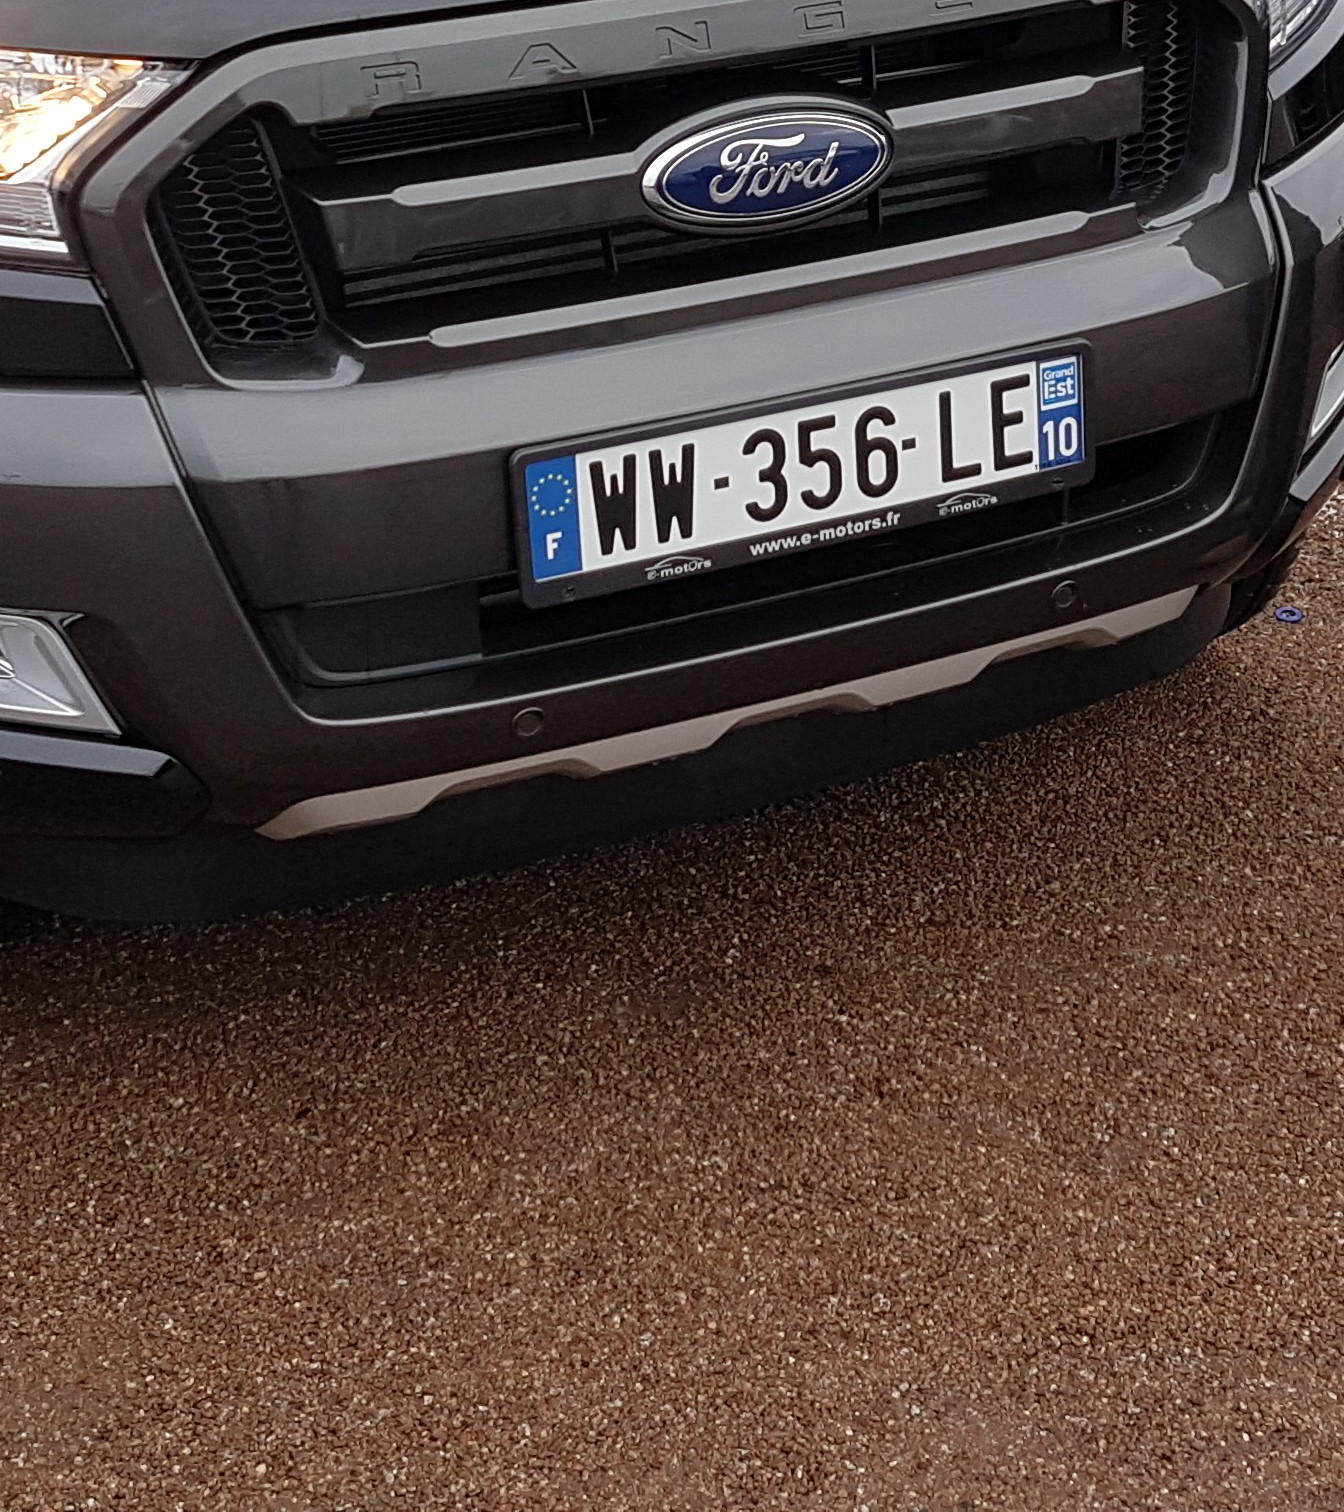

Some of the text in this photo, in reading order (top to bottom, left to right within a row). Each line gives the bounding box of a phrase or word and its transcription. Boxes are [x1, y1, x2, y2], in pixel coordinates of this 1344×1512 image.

[708, 132, 838, 204] Ford
[1043, 365, 1074, 380] Grand
[1044, 377, 1074, 399] Est
[1042, 417, 1078, 461] 10
[590, 374, 1034, 555] WW-356-LE
[547, 532, 562, 560] F
[749, 511, 902, 556] www.e-motors.fr
